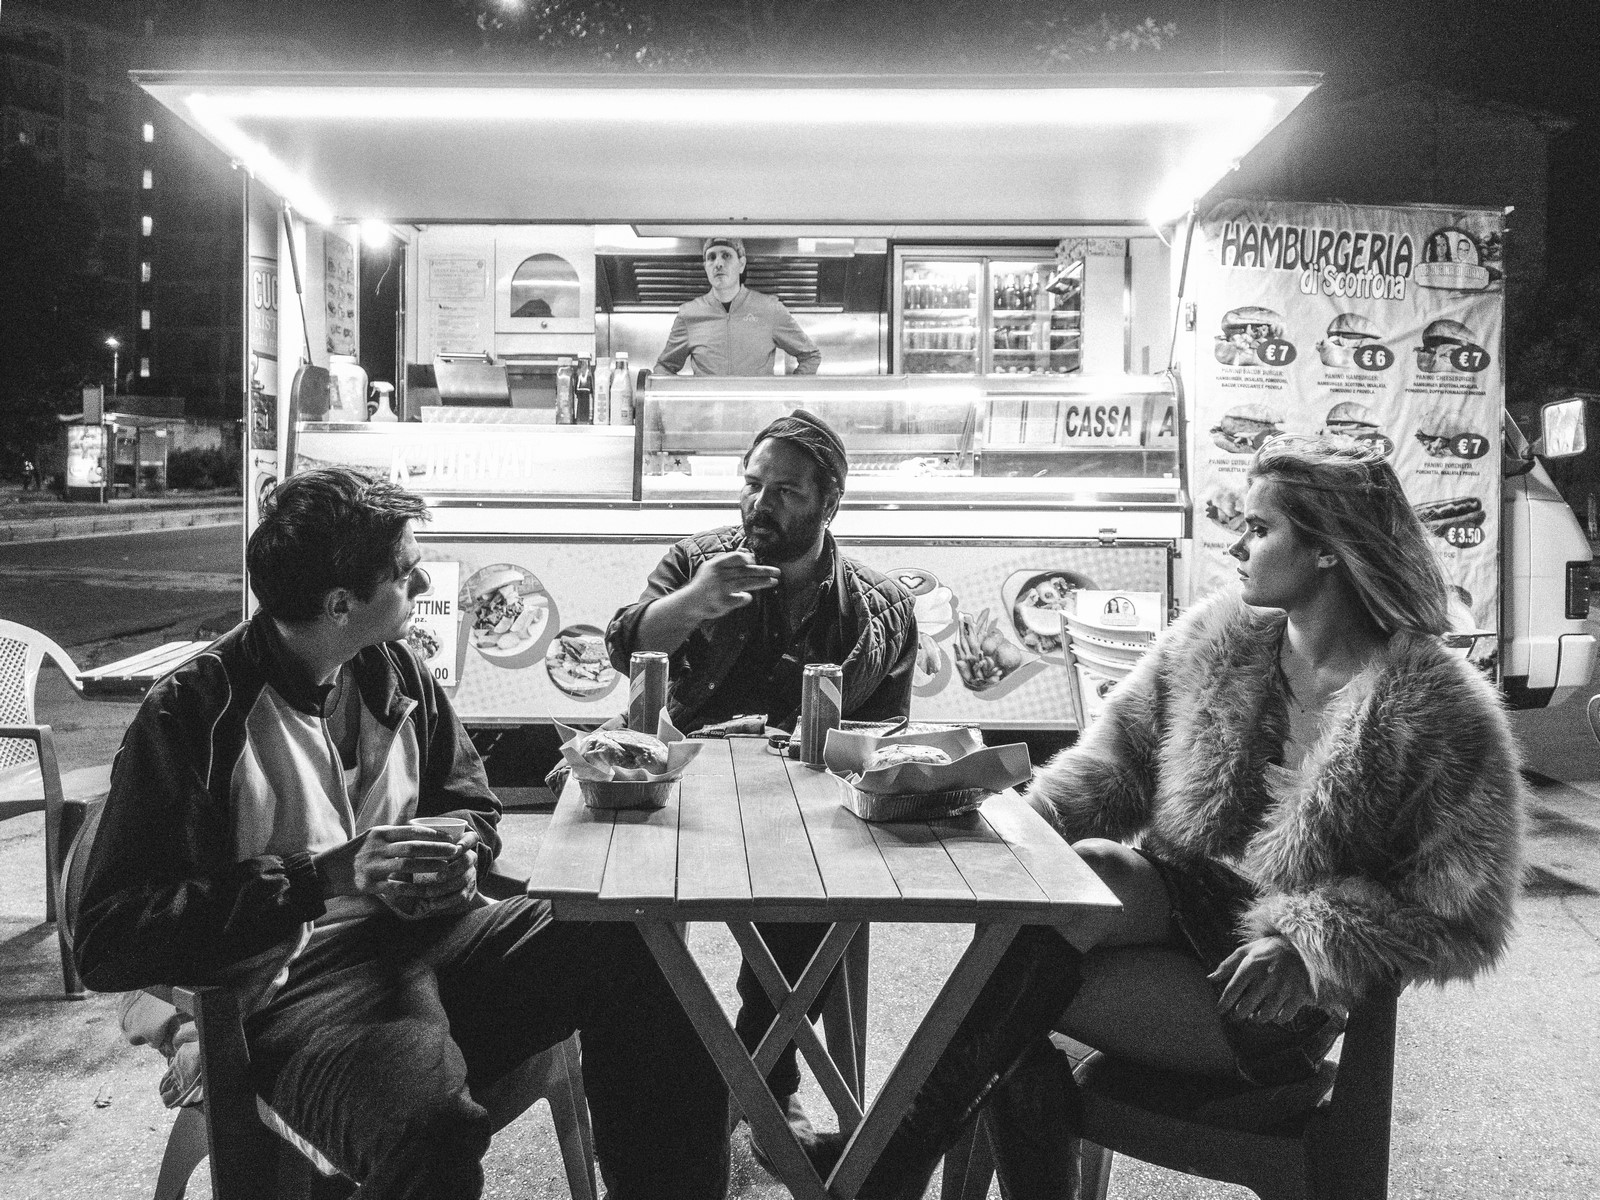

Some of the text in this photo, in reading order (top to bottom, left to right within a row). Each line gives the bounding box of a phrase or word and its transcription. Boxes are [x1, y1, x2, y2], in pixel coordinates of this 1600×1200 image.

[1221, 222, 1413, 278] HAMBURGERIA
[1301, 262, 1406, 300] di Scottona
[1066, 405, 1132, 437] CASSA
[434, 667, 448, 680] 00
